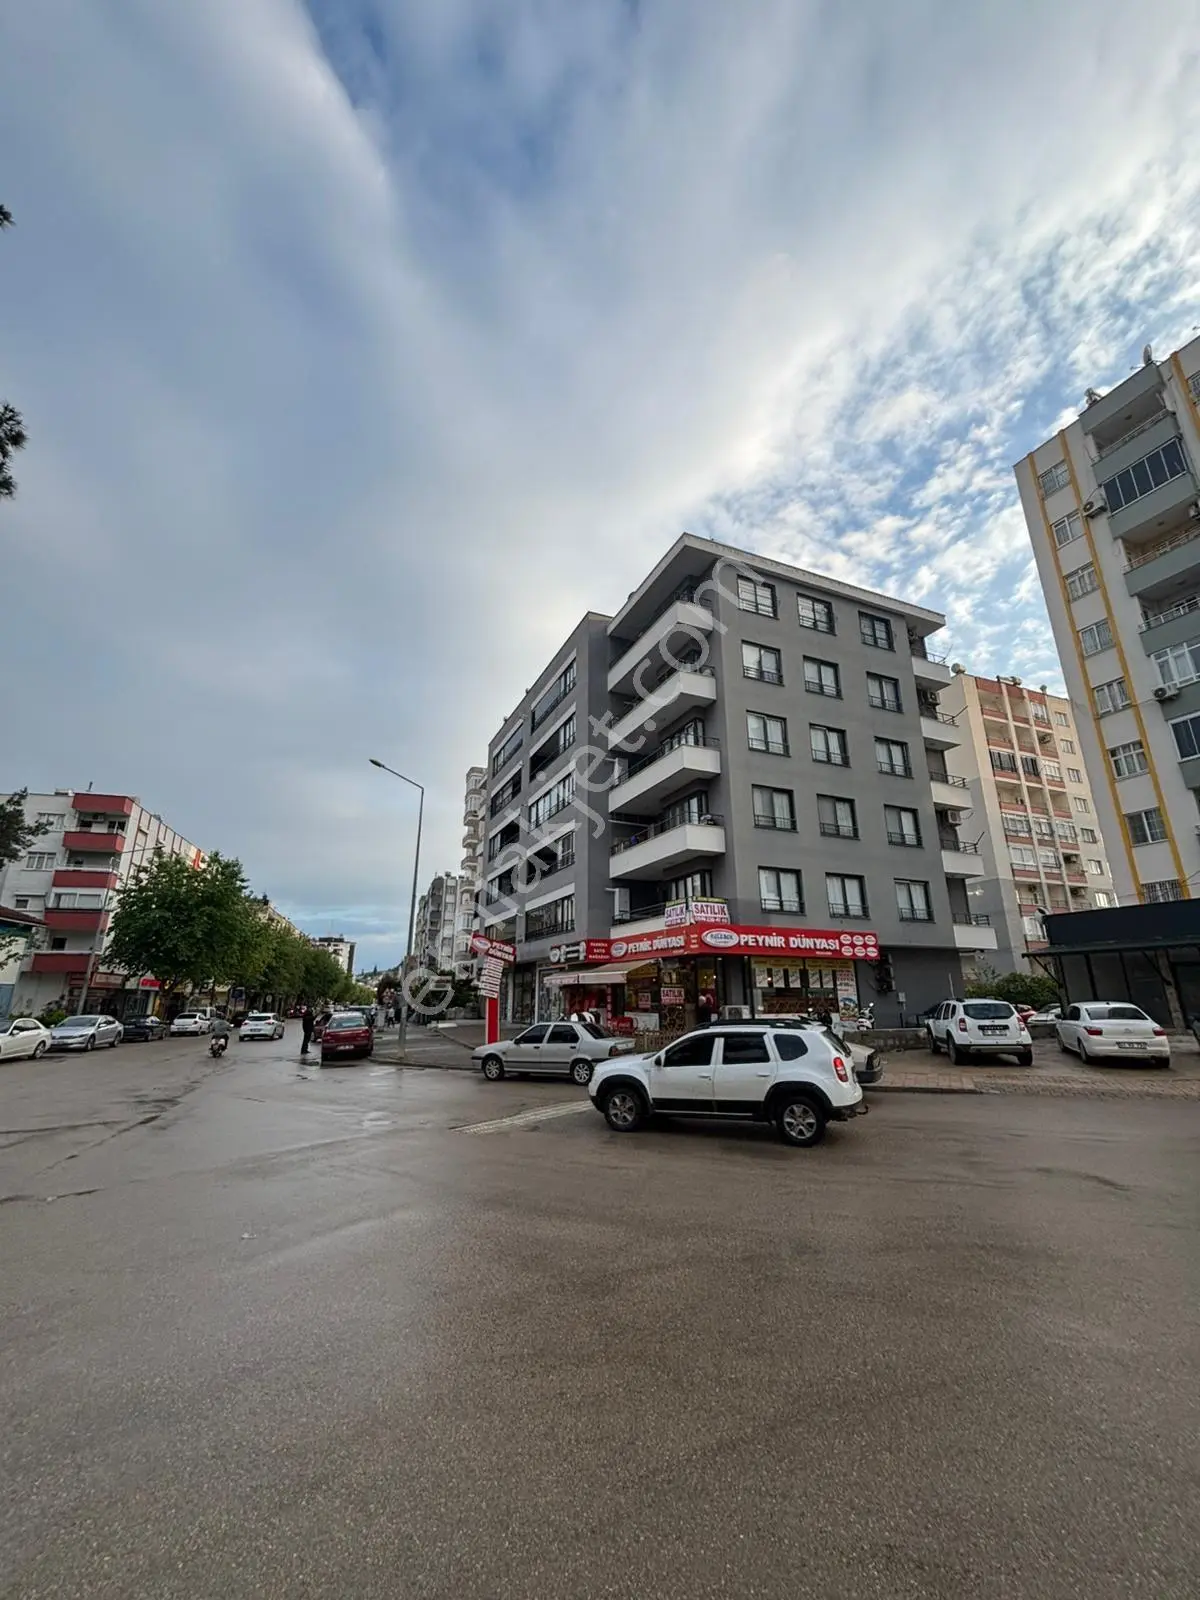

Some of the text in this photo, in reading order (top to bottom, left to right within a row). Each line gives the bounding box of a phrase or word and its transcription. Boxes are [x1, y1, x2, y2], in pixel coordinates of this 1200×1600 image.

[694, 903, 727, 916] SATILIK
[739, 932, 786, 948] PEYNİR
[789, 933, 840, 950] DÜNYASI
